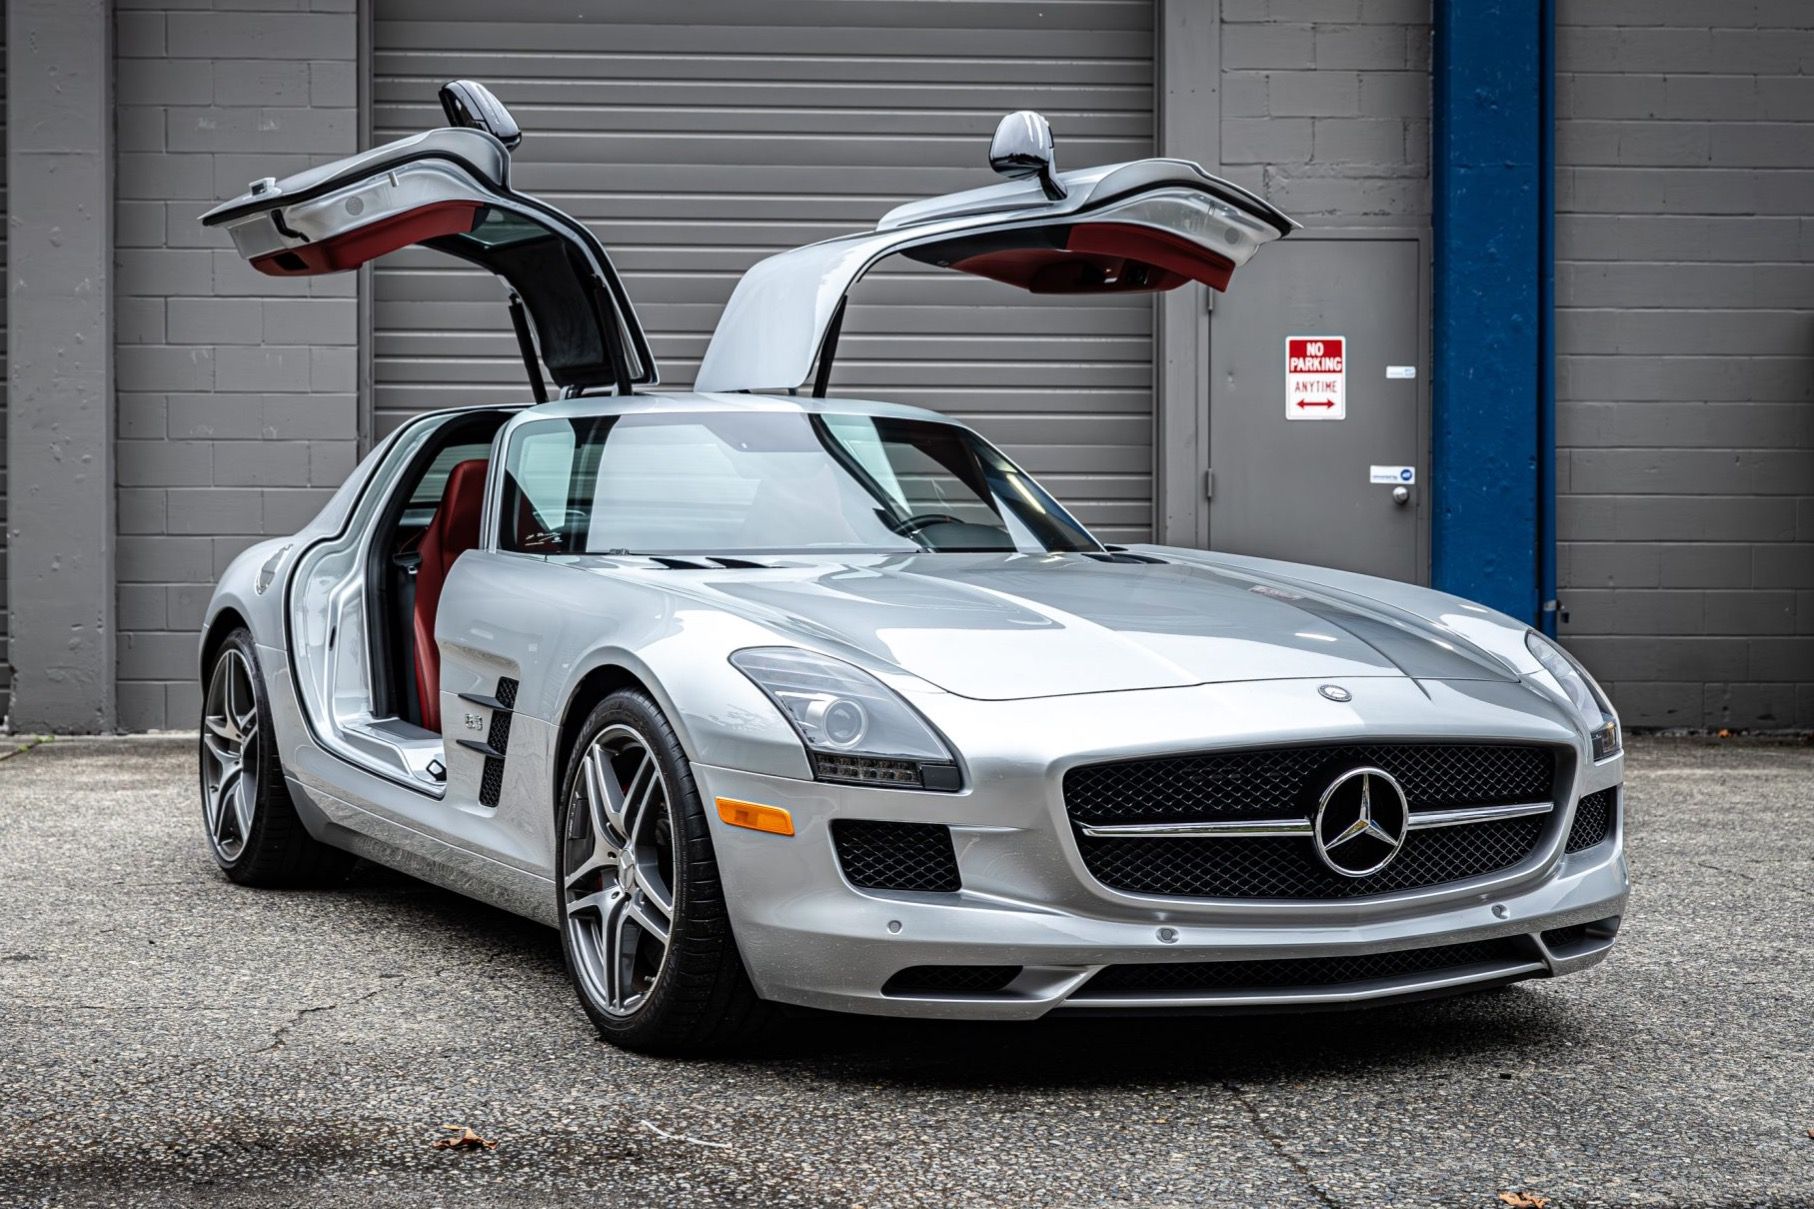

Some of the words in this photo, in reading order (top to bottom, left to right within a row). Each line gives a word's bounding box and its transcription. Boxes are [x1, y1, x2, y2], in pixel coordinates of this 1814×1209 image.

[1306, 341, 1324, 357] NO
[1290, 357, 1342, 372] PARKING
[1295, 380, 1337, 393] ANYTIME
